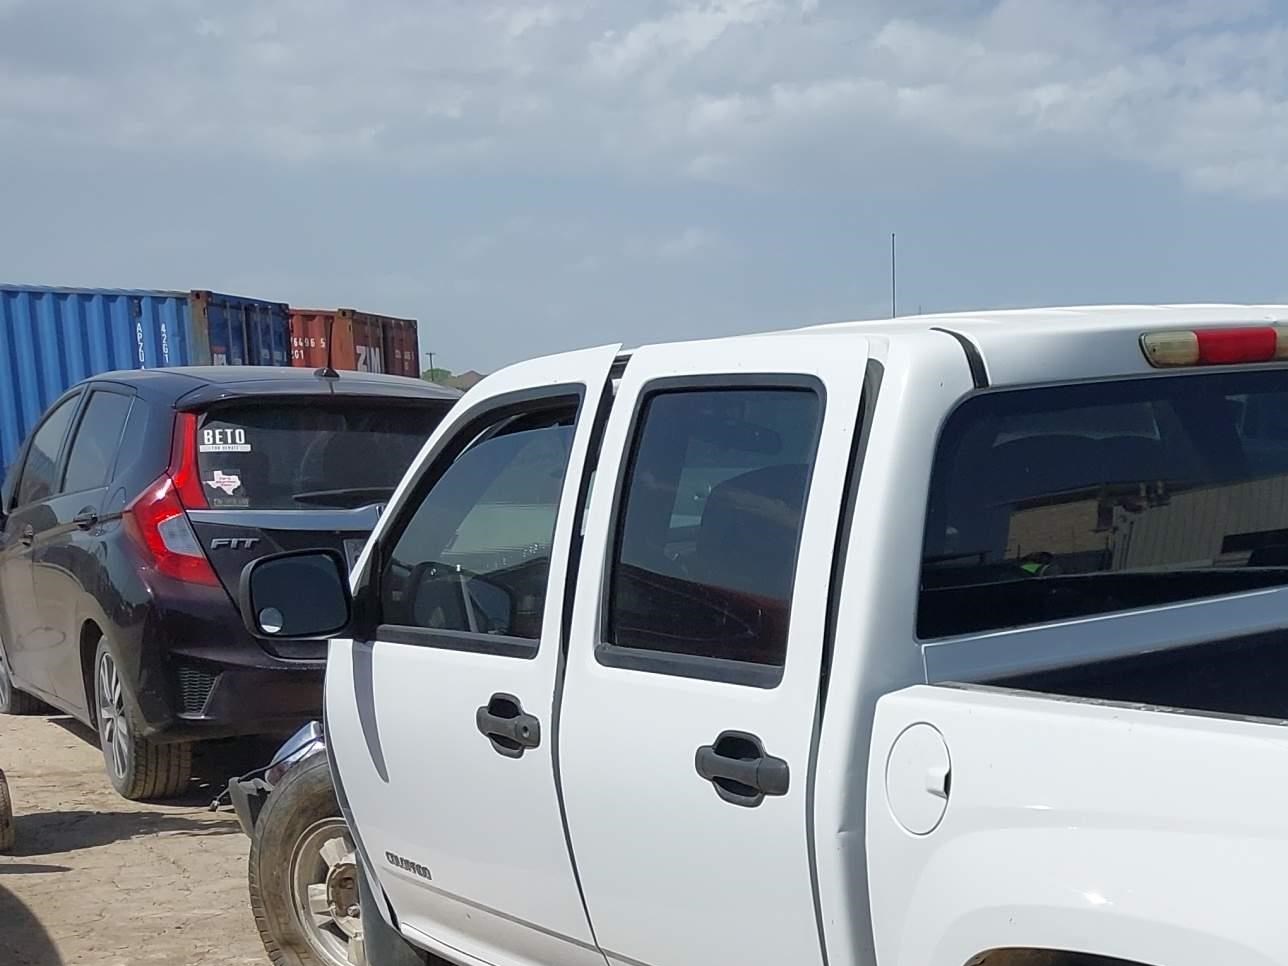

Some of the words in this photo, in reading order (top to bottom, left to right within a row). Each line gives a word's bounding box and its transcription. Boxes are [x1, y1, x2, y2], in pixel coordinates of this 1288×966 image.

[136, 323, 145, 362] APZU
[160, 323, 169, 364] 42G1
[356, 345, 381, 374] ZIM
[203, 428, 246, 445] BETO
[210, 537, 260, 549] FIT
